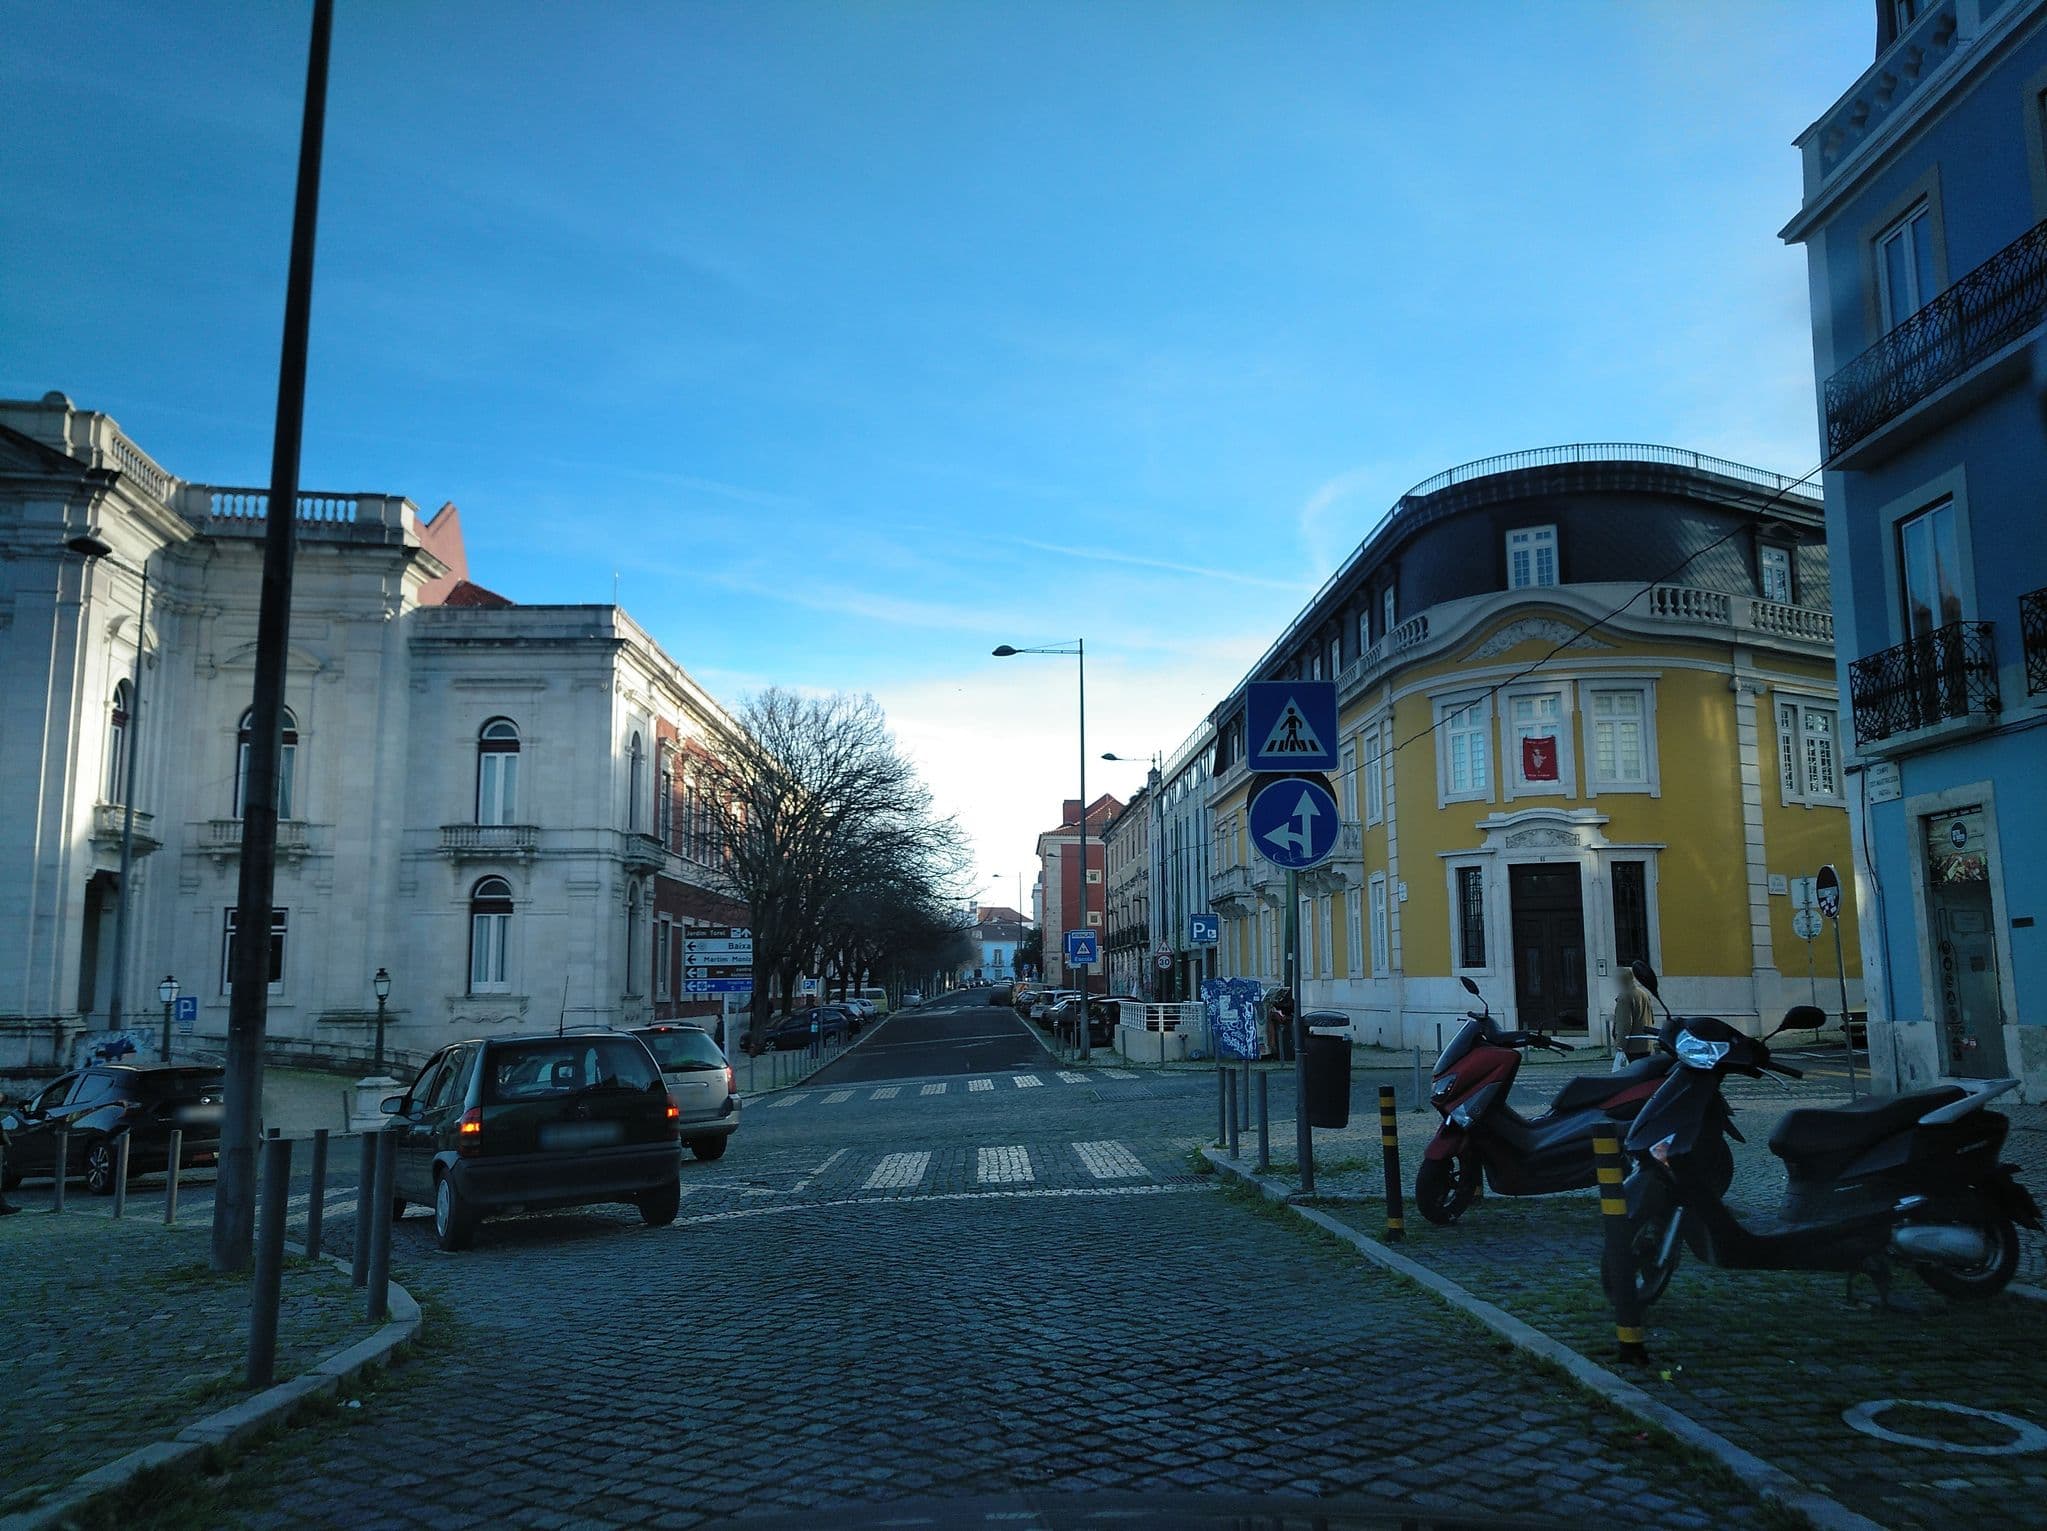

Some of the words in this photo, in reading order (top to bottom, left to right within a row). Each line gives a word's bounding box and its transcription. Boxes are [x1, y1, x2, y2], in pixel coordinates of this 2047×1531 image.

[1193, 922, 1206, 939] P
[728, 942, 752, 950] Baixa
[1159, 958, 1170, 966] 30
[180, 999, 194, 1019] P
